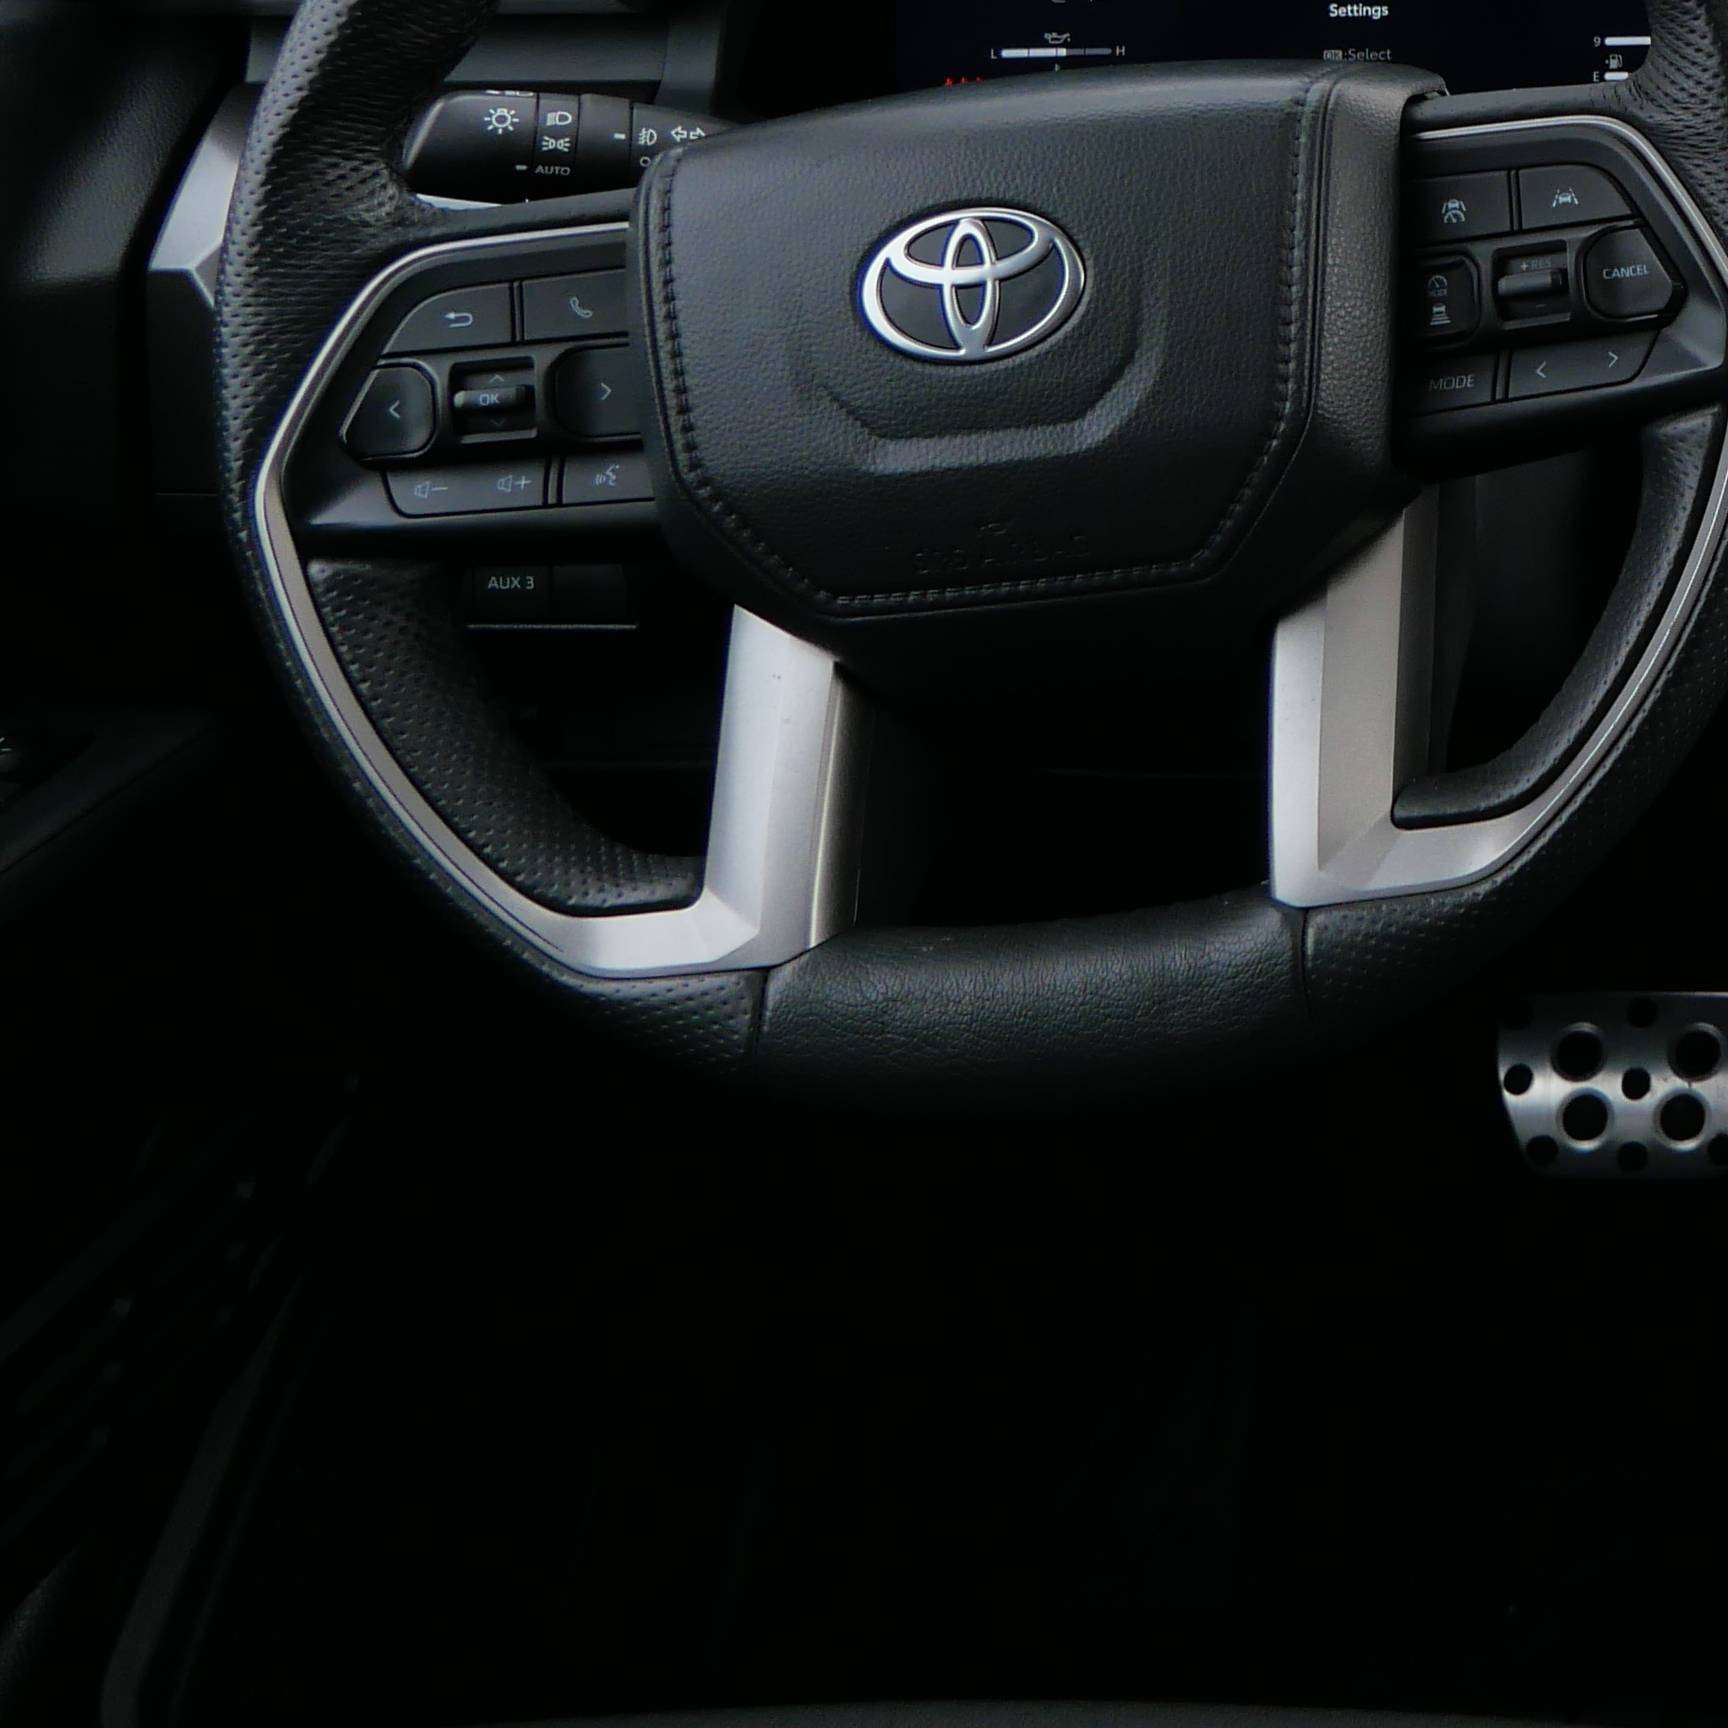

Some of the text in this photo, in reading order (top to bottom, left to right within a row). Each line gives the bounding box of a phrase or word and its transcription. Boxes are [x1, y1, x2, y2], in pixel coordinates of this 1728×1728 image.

[1328, 2, 1390, 19] Settings
[990, 48, 998, 60] L
[1115, 46, 1126, 57] H
[534, 164, 572, 177] AUTO
[1602, 263, 1650, 281] CANCEL
[1427, 373, 1476, 390] MODE
[479, 393, 500, 407] OK
[487, 575, 535, 590] AUX 3
